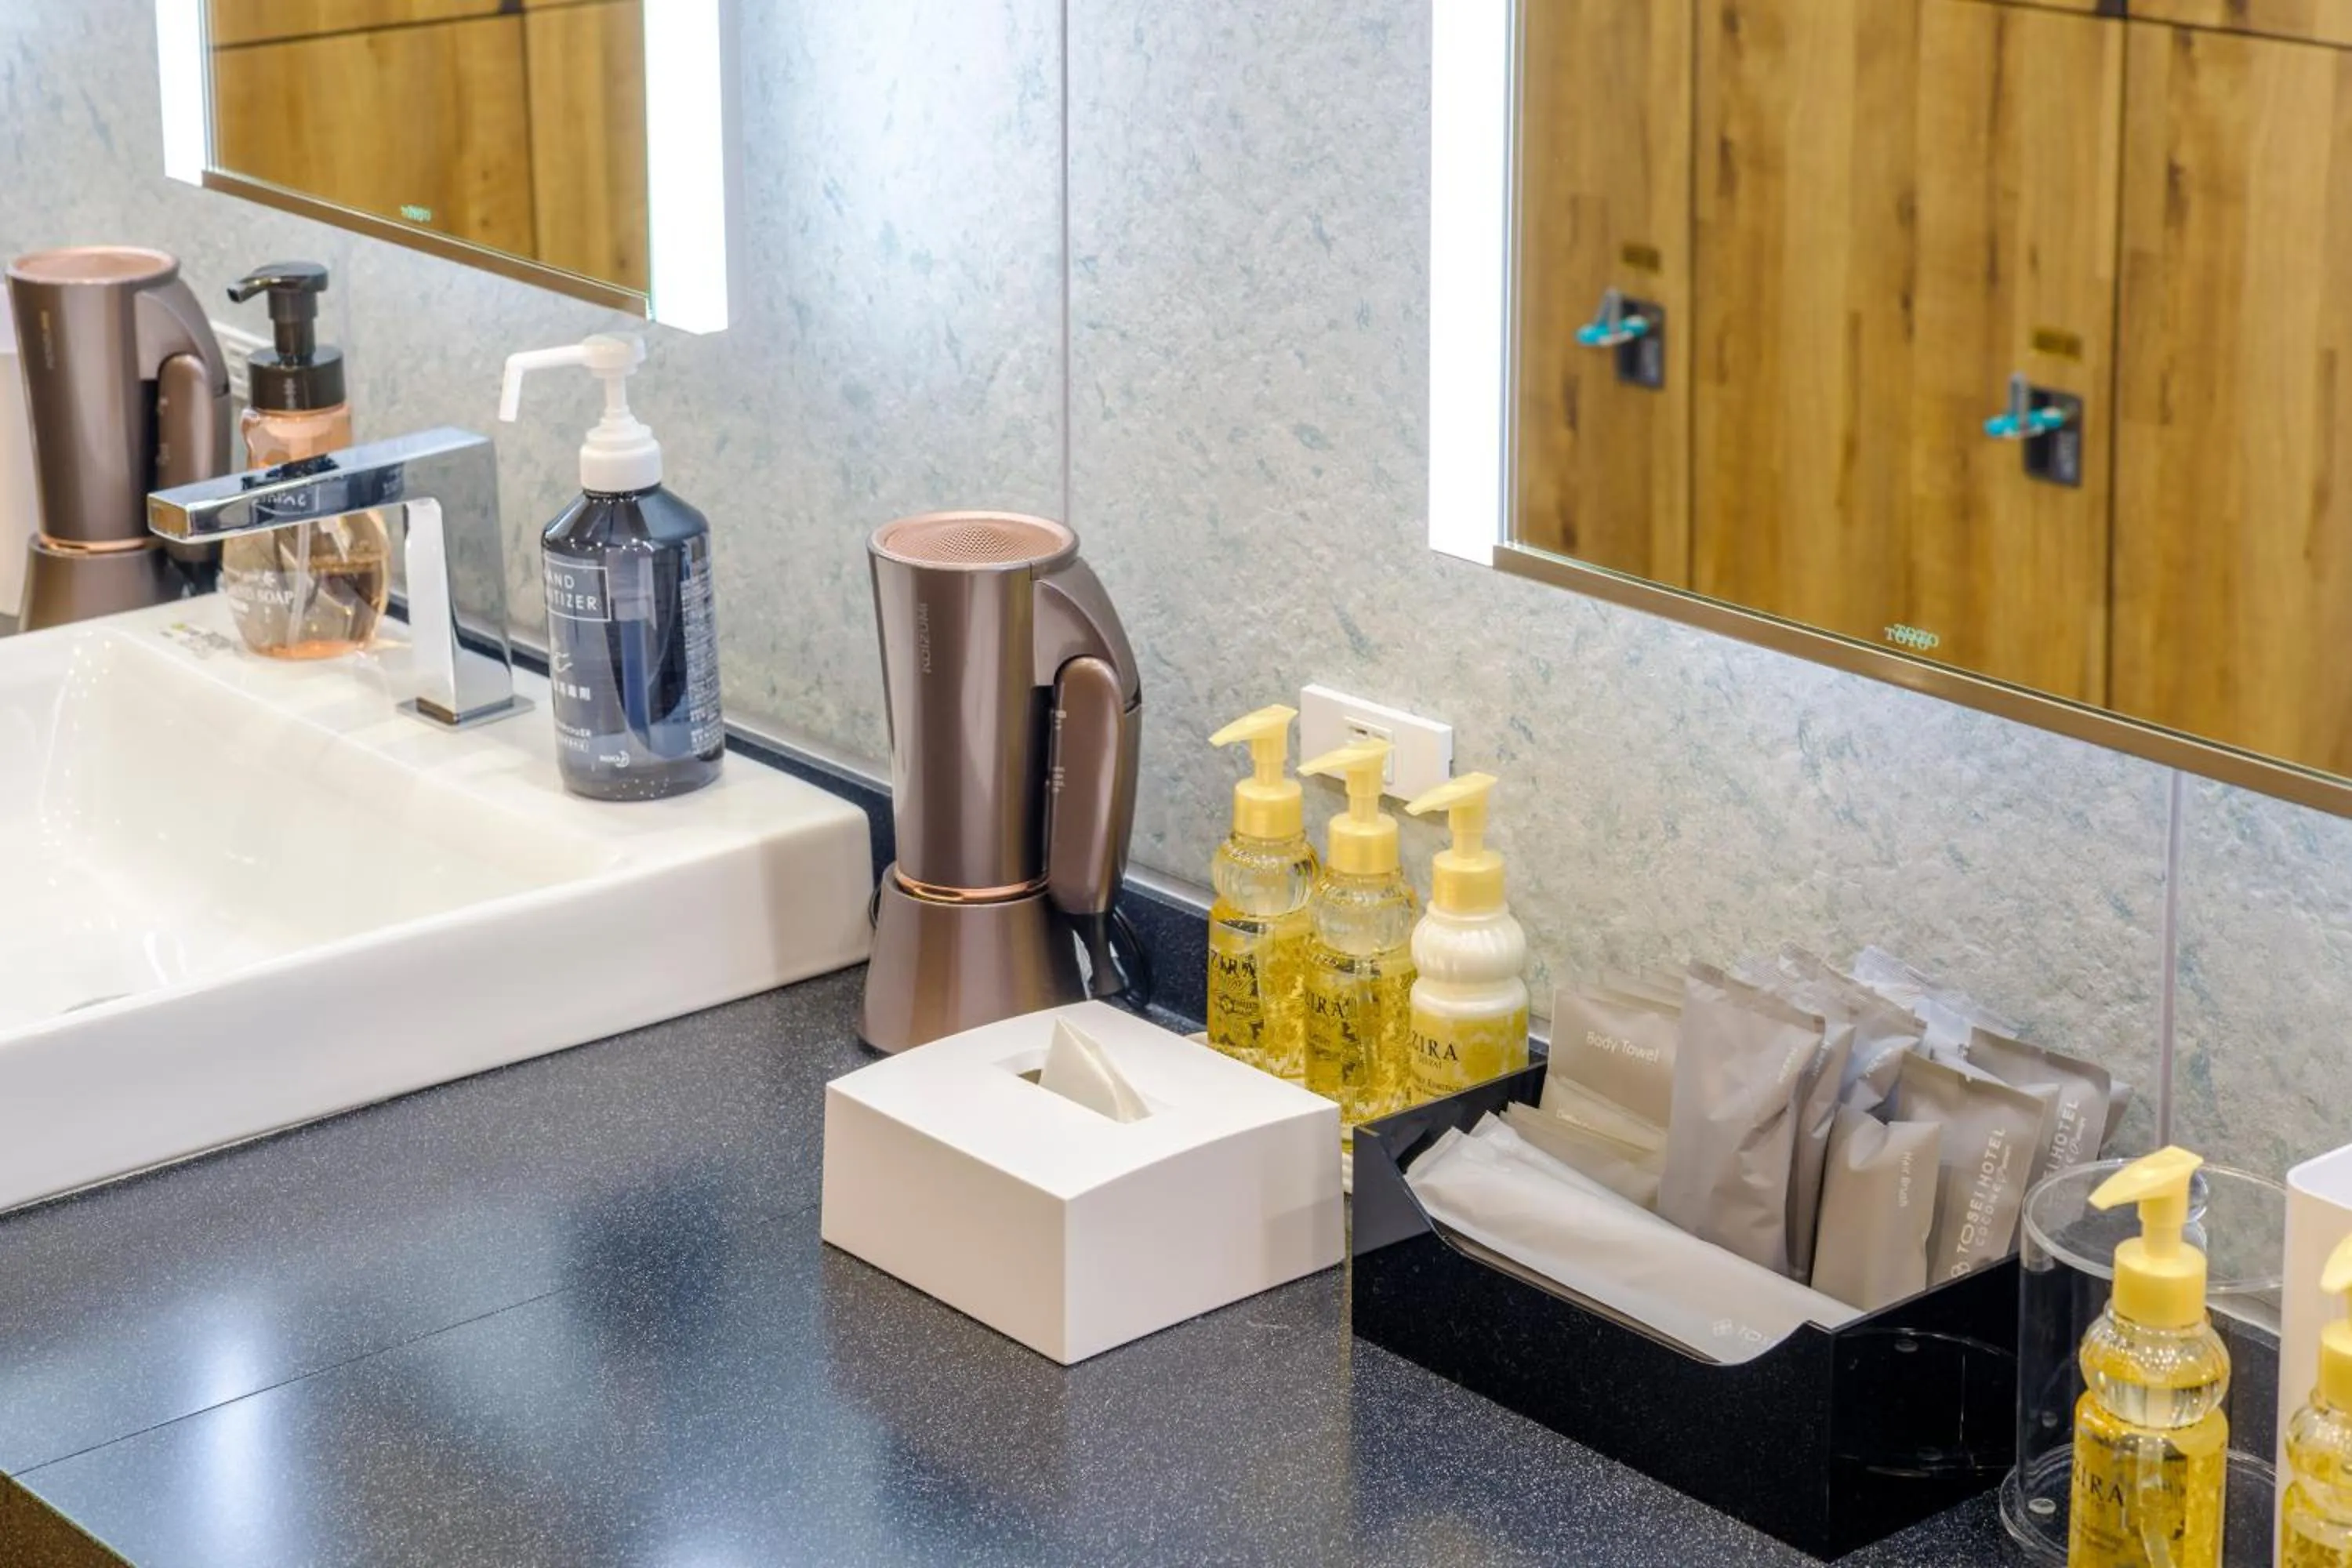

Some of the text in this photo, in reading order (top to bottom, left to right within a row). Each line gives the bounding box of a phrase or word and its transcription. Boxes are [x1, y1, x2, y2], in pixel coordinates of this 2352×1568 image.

[1412, 1029, 1459, 1061] ZIRA
[1586, 1030, 1660, 1064] Body Towel
[2049, 1102, 2079, 1158] HOTEL
[1956, 1189, 1986, 1254] TOSEI
[1976, 1126, 2006, 1189] HOTEL
